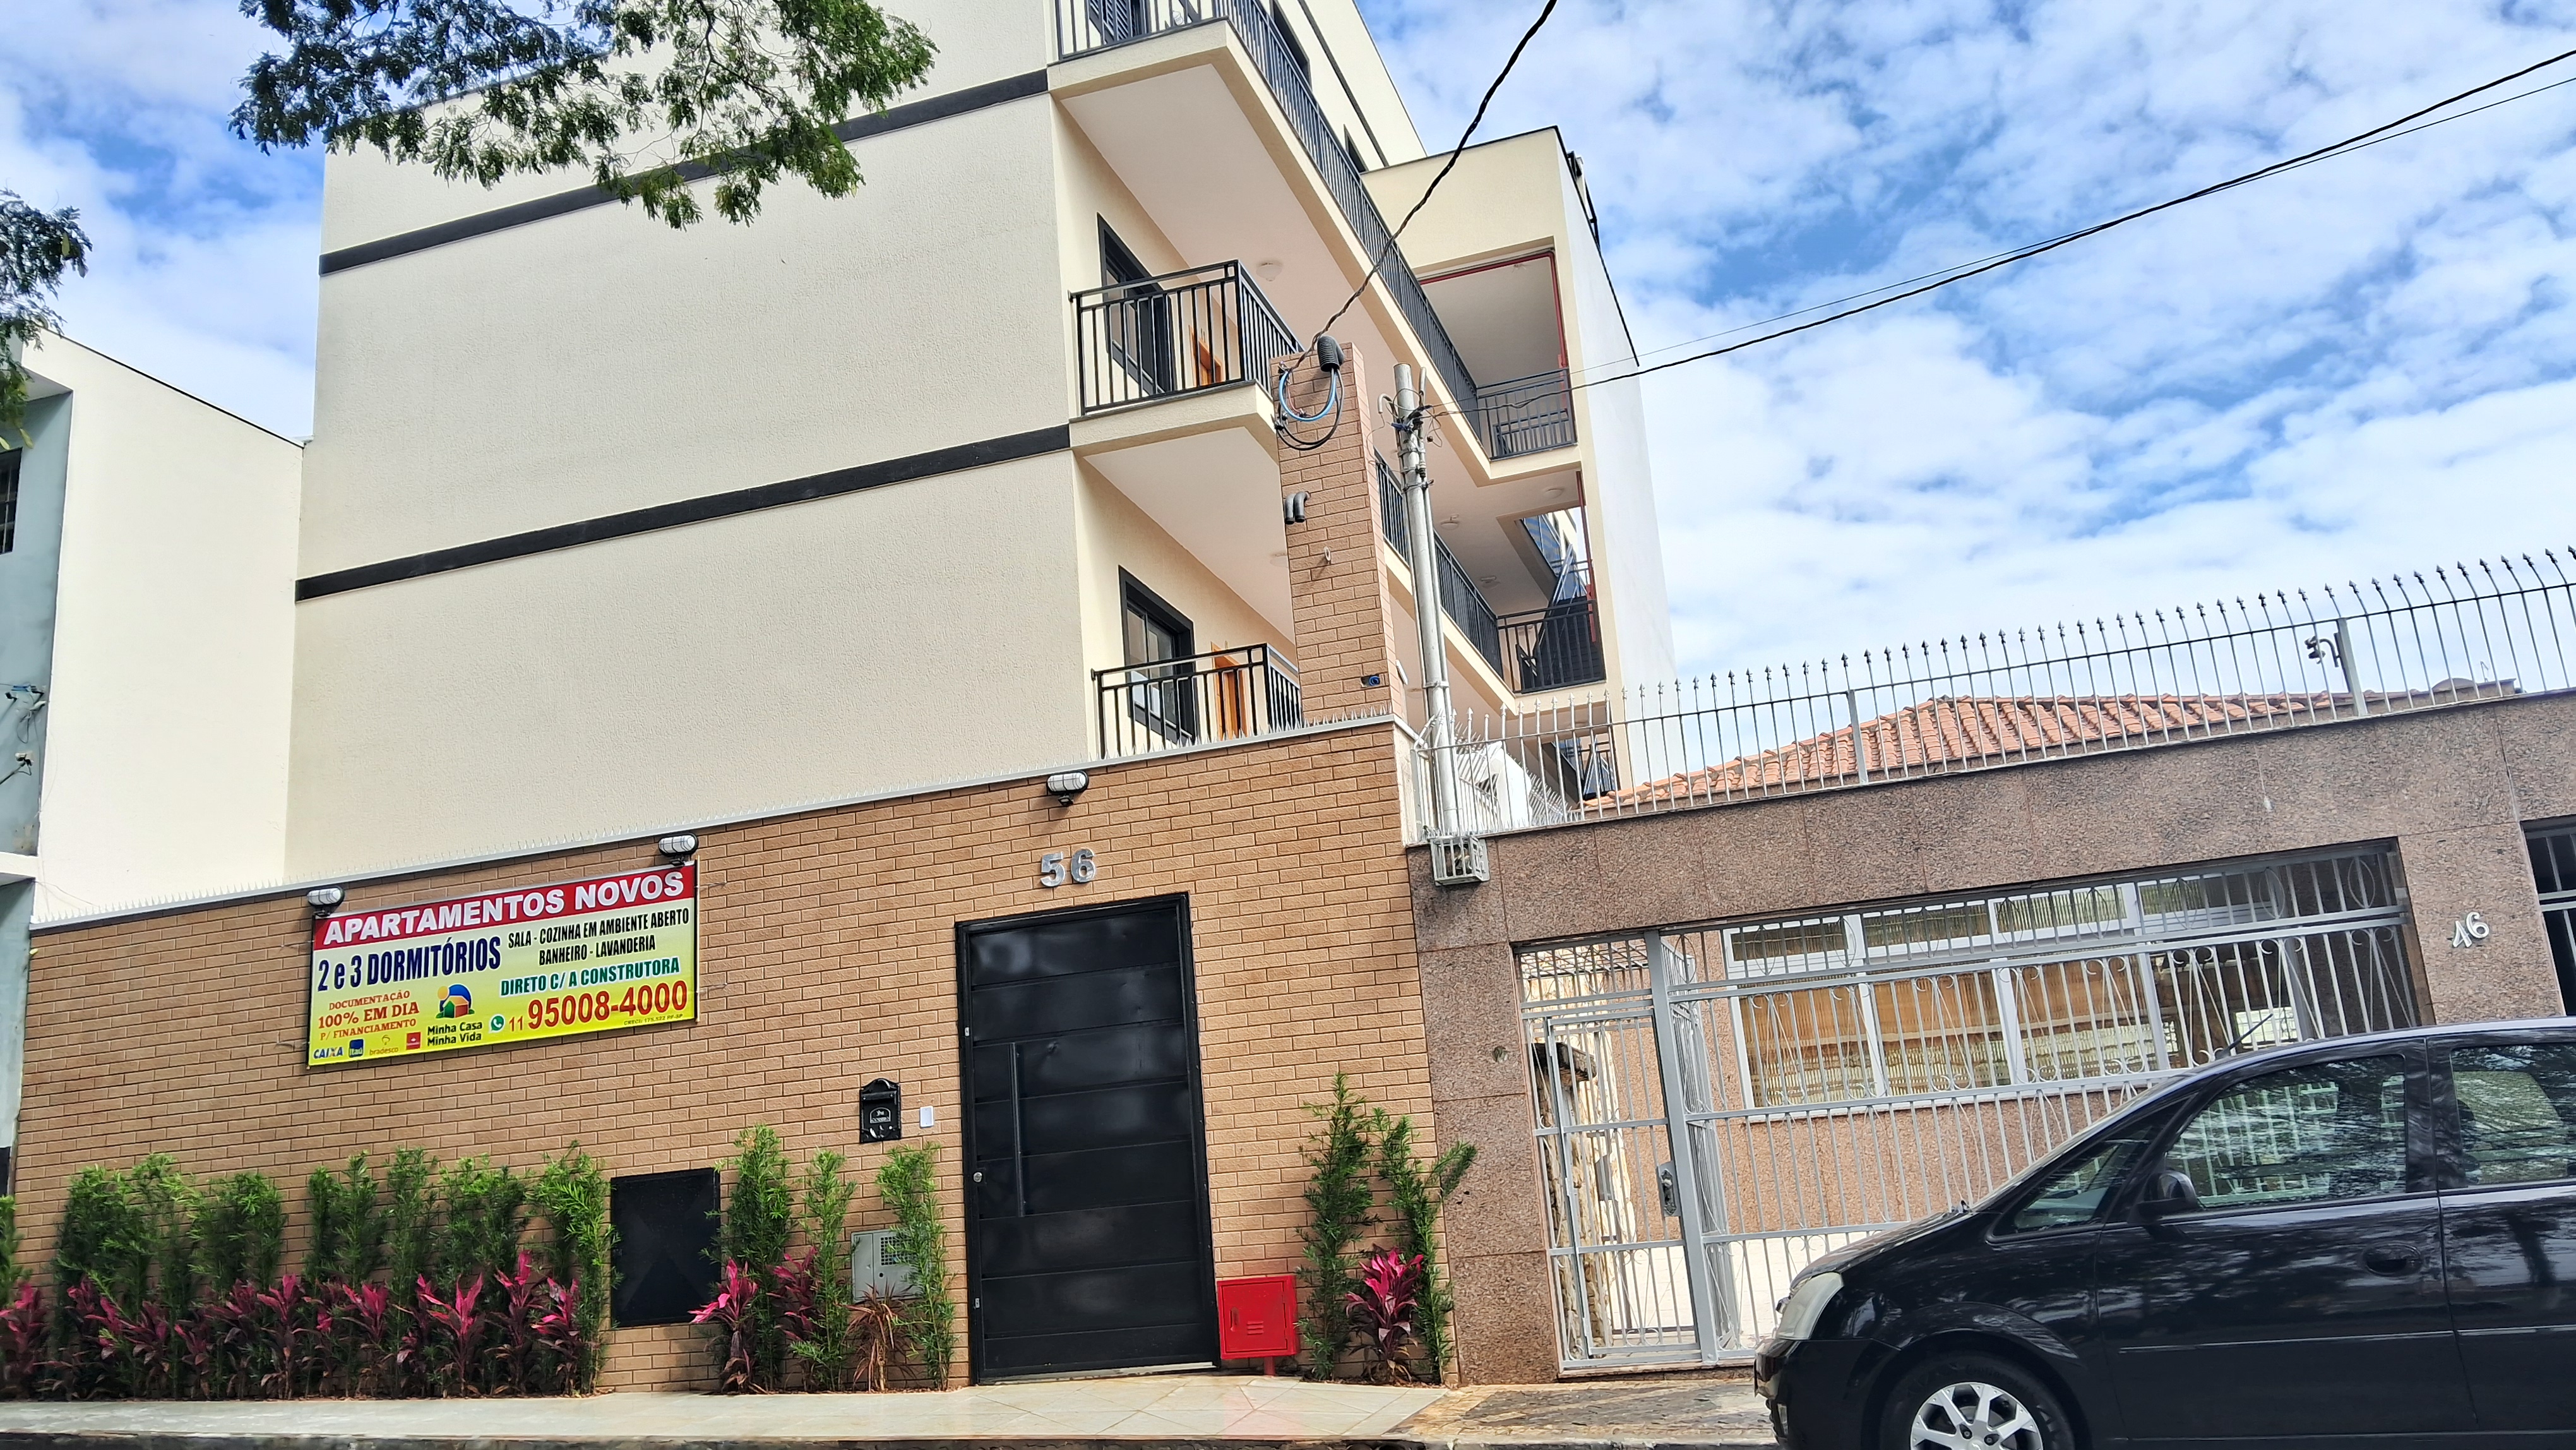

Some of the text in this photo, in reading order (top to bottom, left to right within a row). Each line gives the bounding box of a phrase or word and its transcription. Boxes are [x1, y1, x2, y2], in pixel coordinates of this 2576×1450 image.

[1041, 848, 1096, 887] 56
[323, 872, 684, 945] APARTAMENTOS NOVOS
[508, 930, 532, 949] SALA
[539, 923, 581, 945] COZINHA
[583, 920, 597, 938] EM
[599, 913, 649, 936] AMBIENTE
[650, 908, 689, 929] ABERTO
[2453, 911, 2490, 948] 46
[318, 935, 501, 992] 2 e 3 DORMITÓRIOS
[539, 944, 588, 966] BANHEIRO
[596, 934, 656, 958] LAVANDERIA
[501, 957, 680, 996] DIRETO C/ A CONSTRUTORA
[318, 1002, 420, 1029] 100% EM DIA
[329, 990, 411, 1010] DOCUMENTAÇÃO
[509, 980, 688, 1032] 11 95008-4000
[333, 1018, 417, 1040] FINANCIAMENTO
[427, 1021, 483, 1036] Minha Casa
[427, 1036, 456, 1046] Minha
[460, 1031, 482, 1042] Vida
[313, 1046, 343, 1059] CAIXA
[369, 1047, 399, 1056] bradesco
